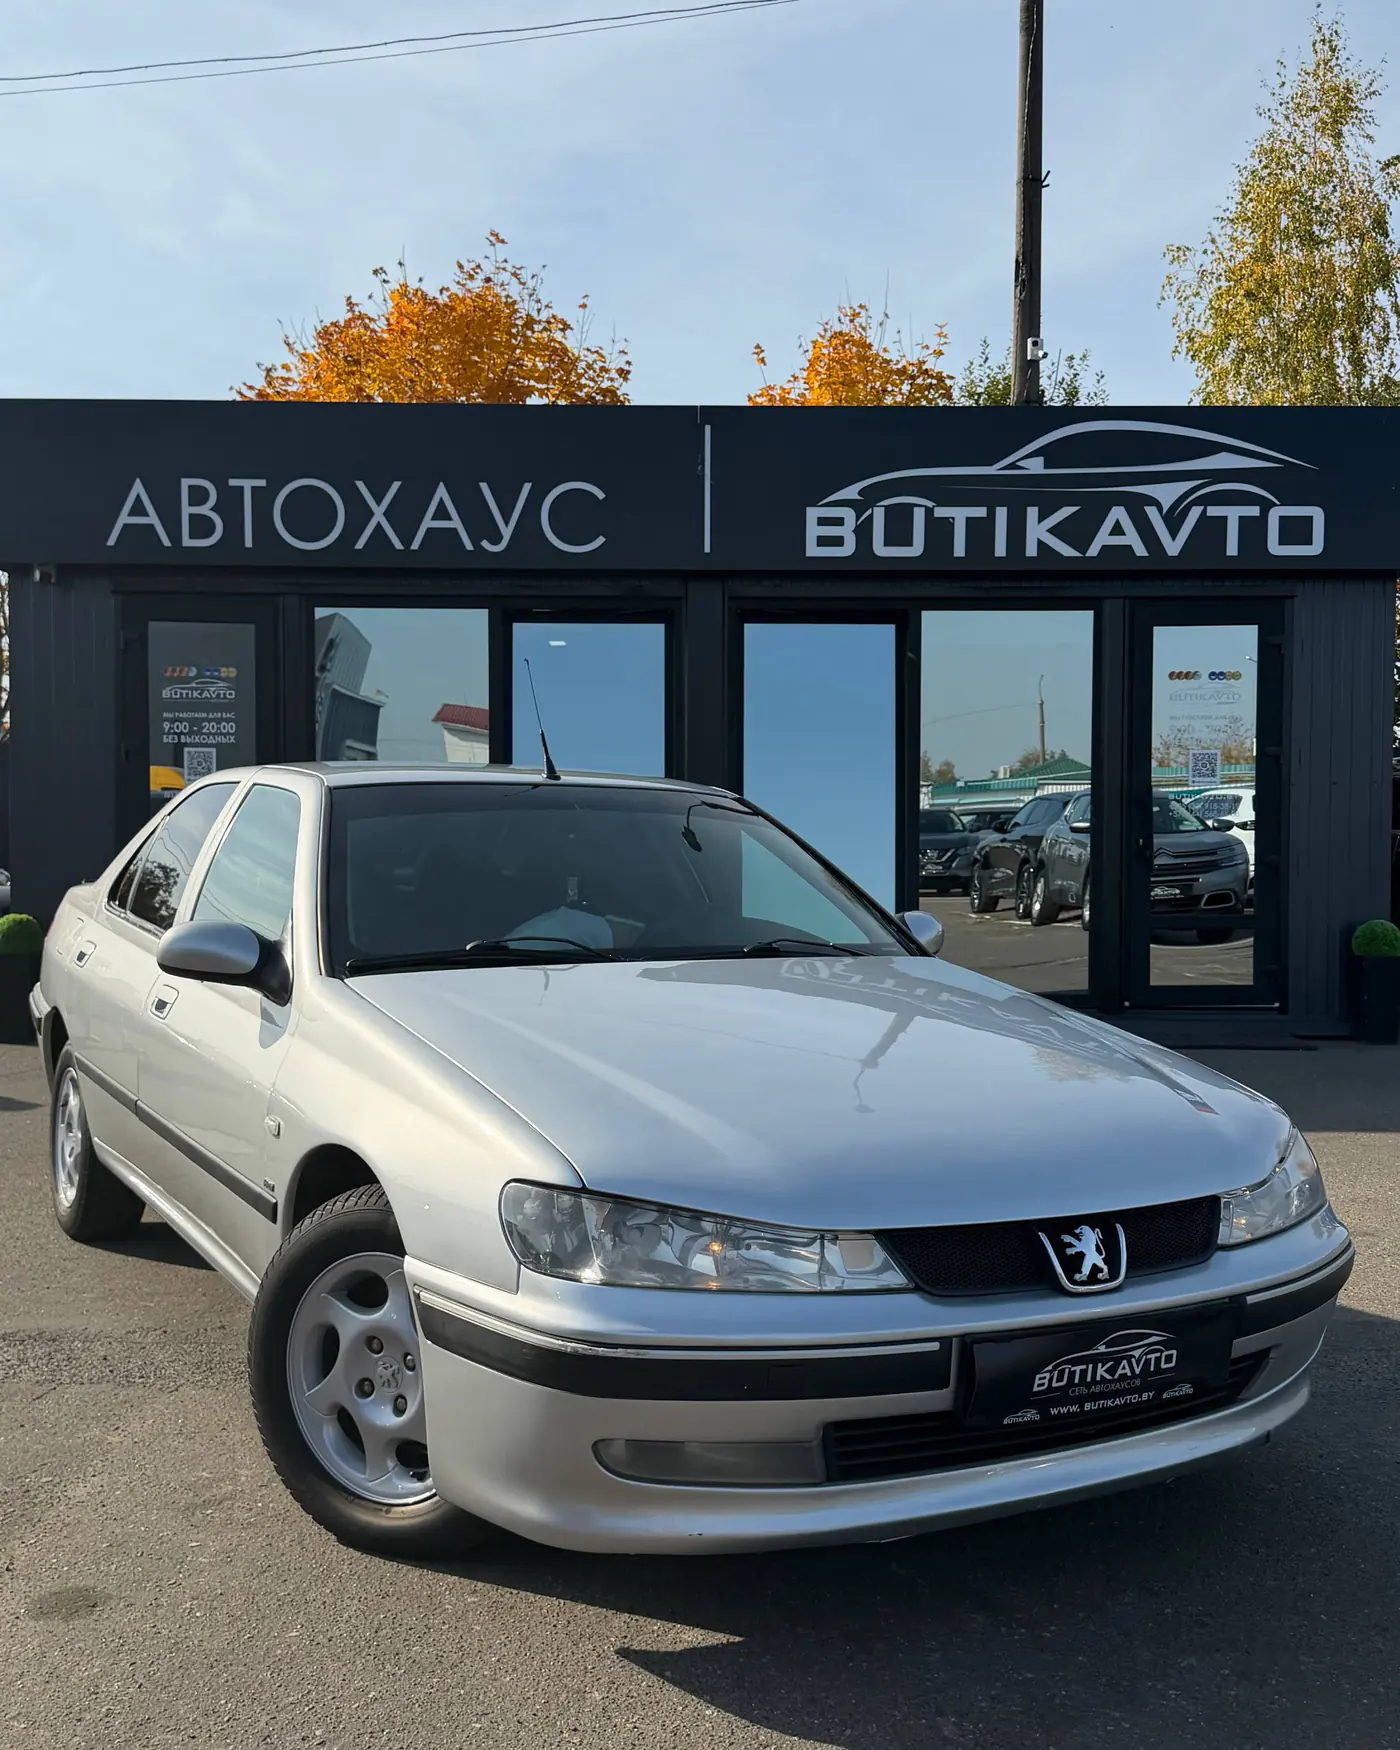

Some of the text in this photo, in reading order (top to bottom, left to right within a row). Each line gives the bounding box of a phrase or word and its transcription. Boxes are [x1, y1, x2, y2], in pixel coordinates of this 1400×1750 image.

[106, 477, 607, 554] АВТОХАУС
[805, 505, 1325, 557] BUTIKAVTO
[162, 689, 236, 699] BUTIKAVTO
[163, 721, 189, 733] 9:00
[202, 721, 236, 733] 20:00
[162, 734, 236, 744] БЕЗ ВЫХОДНЫХ
[1033, 1349, 1177, 1392] BUTIKAVTO
[1068, 1378, 1141, 1396] СЕТЬ АВТОХАУСОВ
[1050, 1391, 1155, 1416] WWW. BUTIKAVTO.BY
